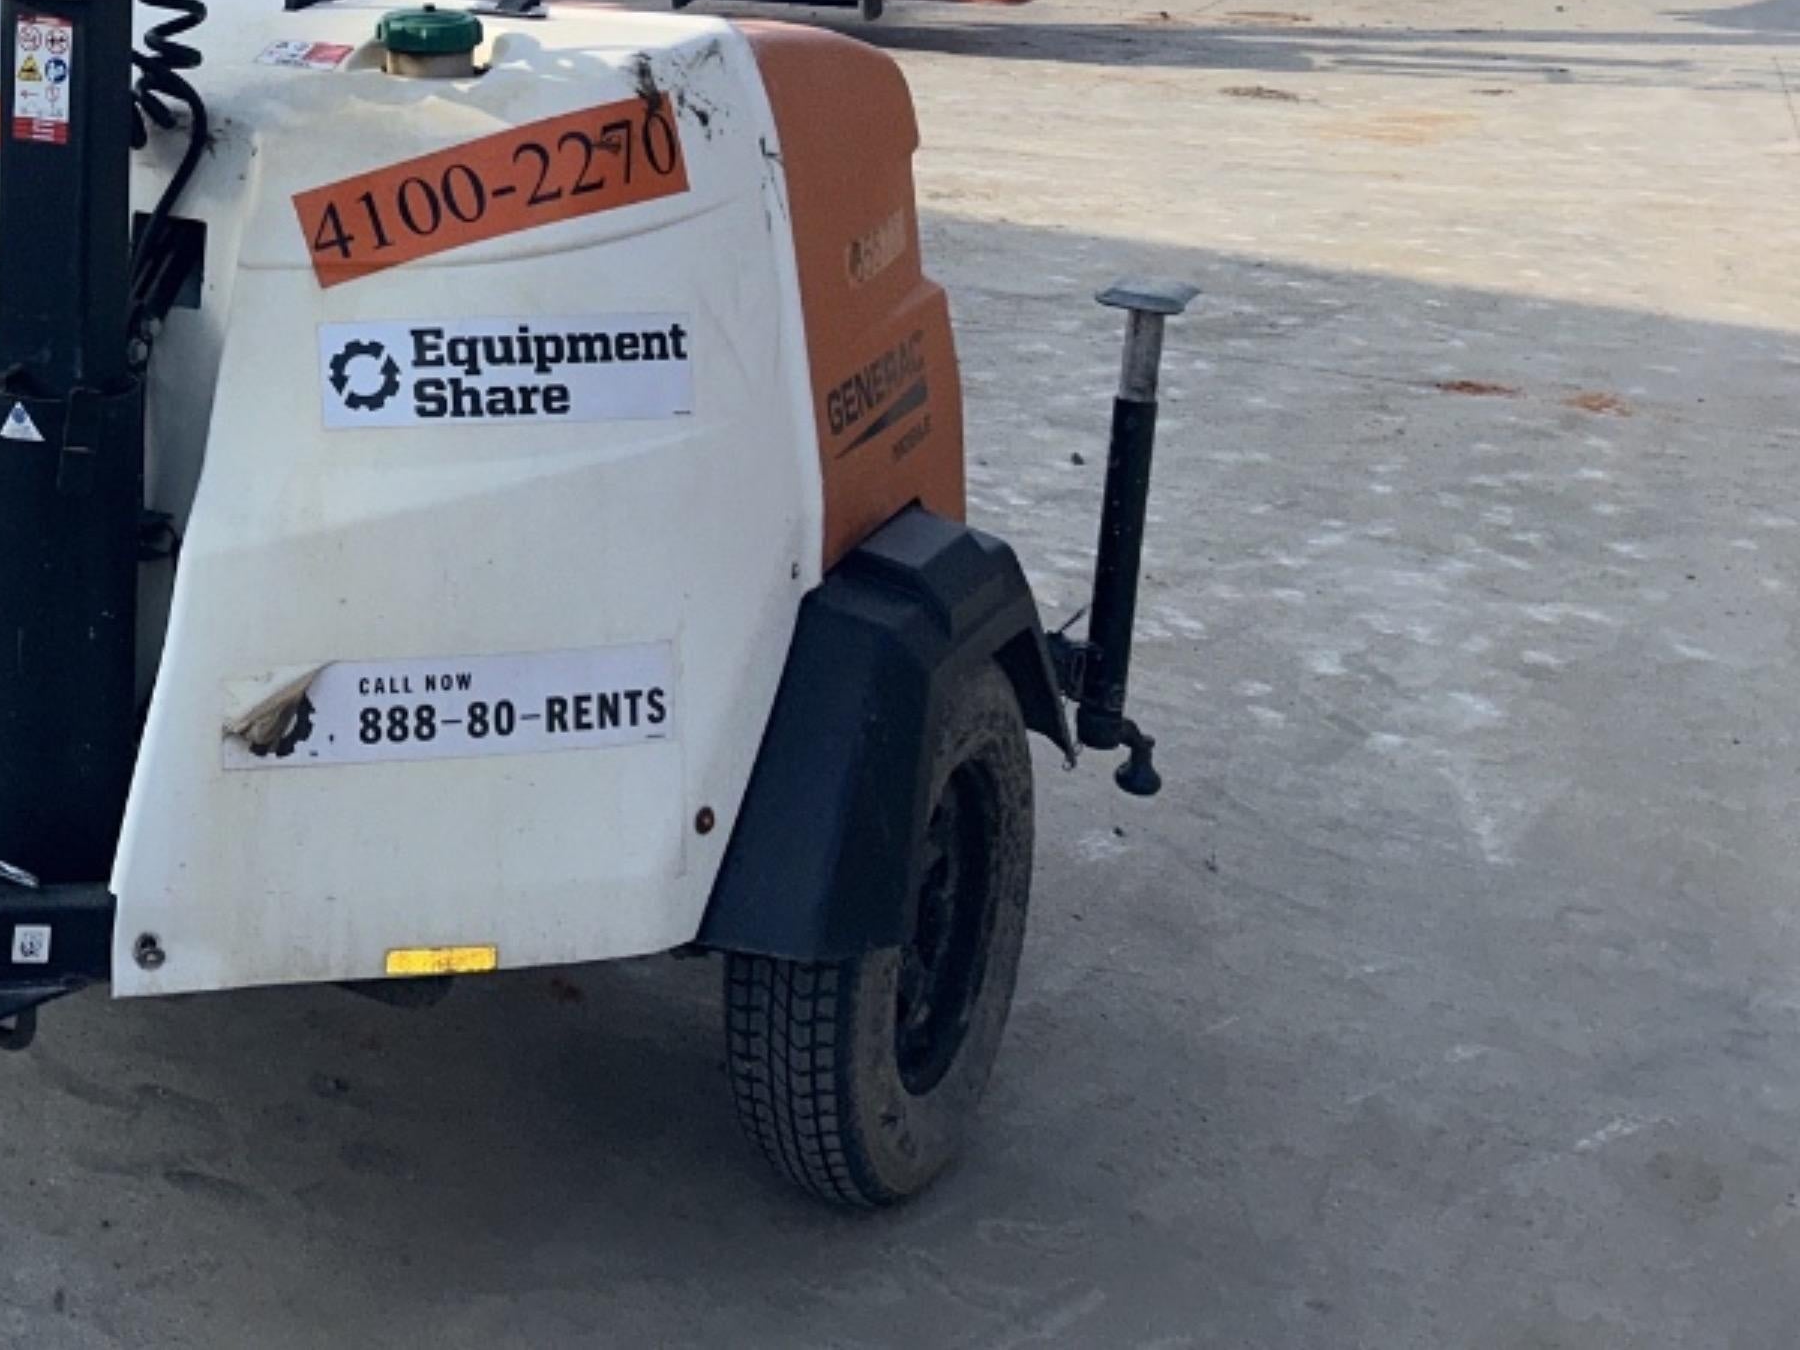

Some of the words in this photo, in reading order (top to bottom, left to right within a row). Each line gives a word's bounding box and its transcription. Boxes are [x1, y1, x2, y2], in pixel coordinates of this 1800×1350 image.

[312, 111, 679, 259] 4100-2270
[409, 323, 689, 375] Equipment
[412, 377, 571, 419] Share
[826, 329, 926, 436] GENERAC
[358, 676, 414, 696] CALL
[425, 672, 474, 693] NOW
[358, 686, 668, 746] 888-80-RENTS
